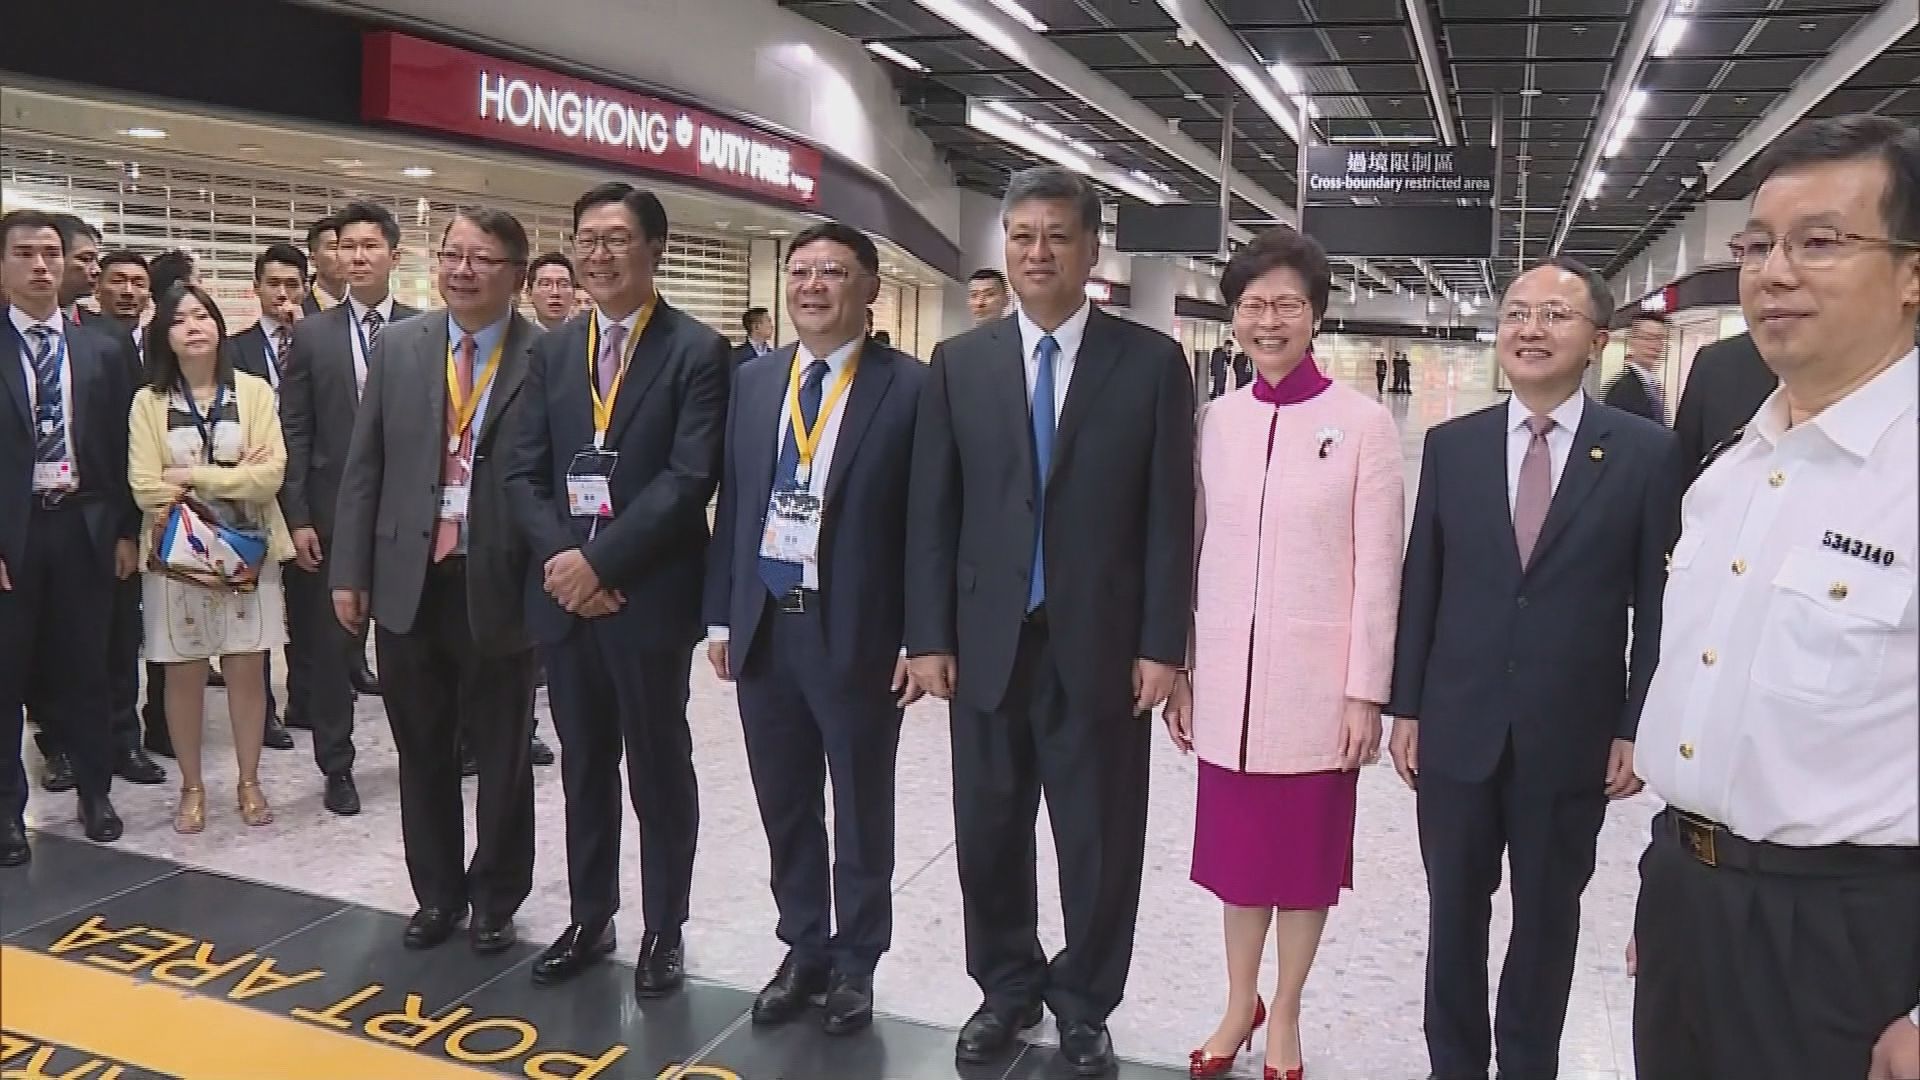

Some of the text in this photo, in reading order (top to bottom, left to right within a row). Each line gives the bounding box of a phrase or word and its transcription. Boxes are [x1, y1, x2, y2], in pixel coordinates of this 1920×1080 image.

[699, 125, 751, 176] DUTY
[1347, 151, 1454, 173] 過境限制區
[1310, 174, 1490, 192] Cross-boundary restricted area
[1822, 530, 1895, 567] 5343140
[47, 914, 629, 1080] PORT AREA
